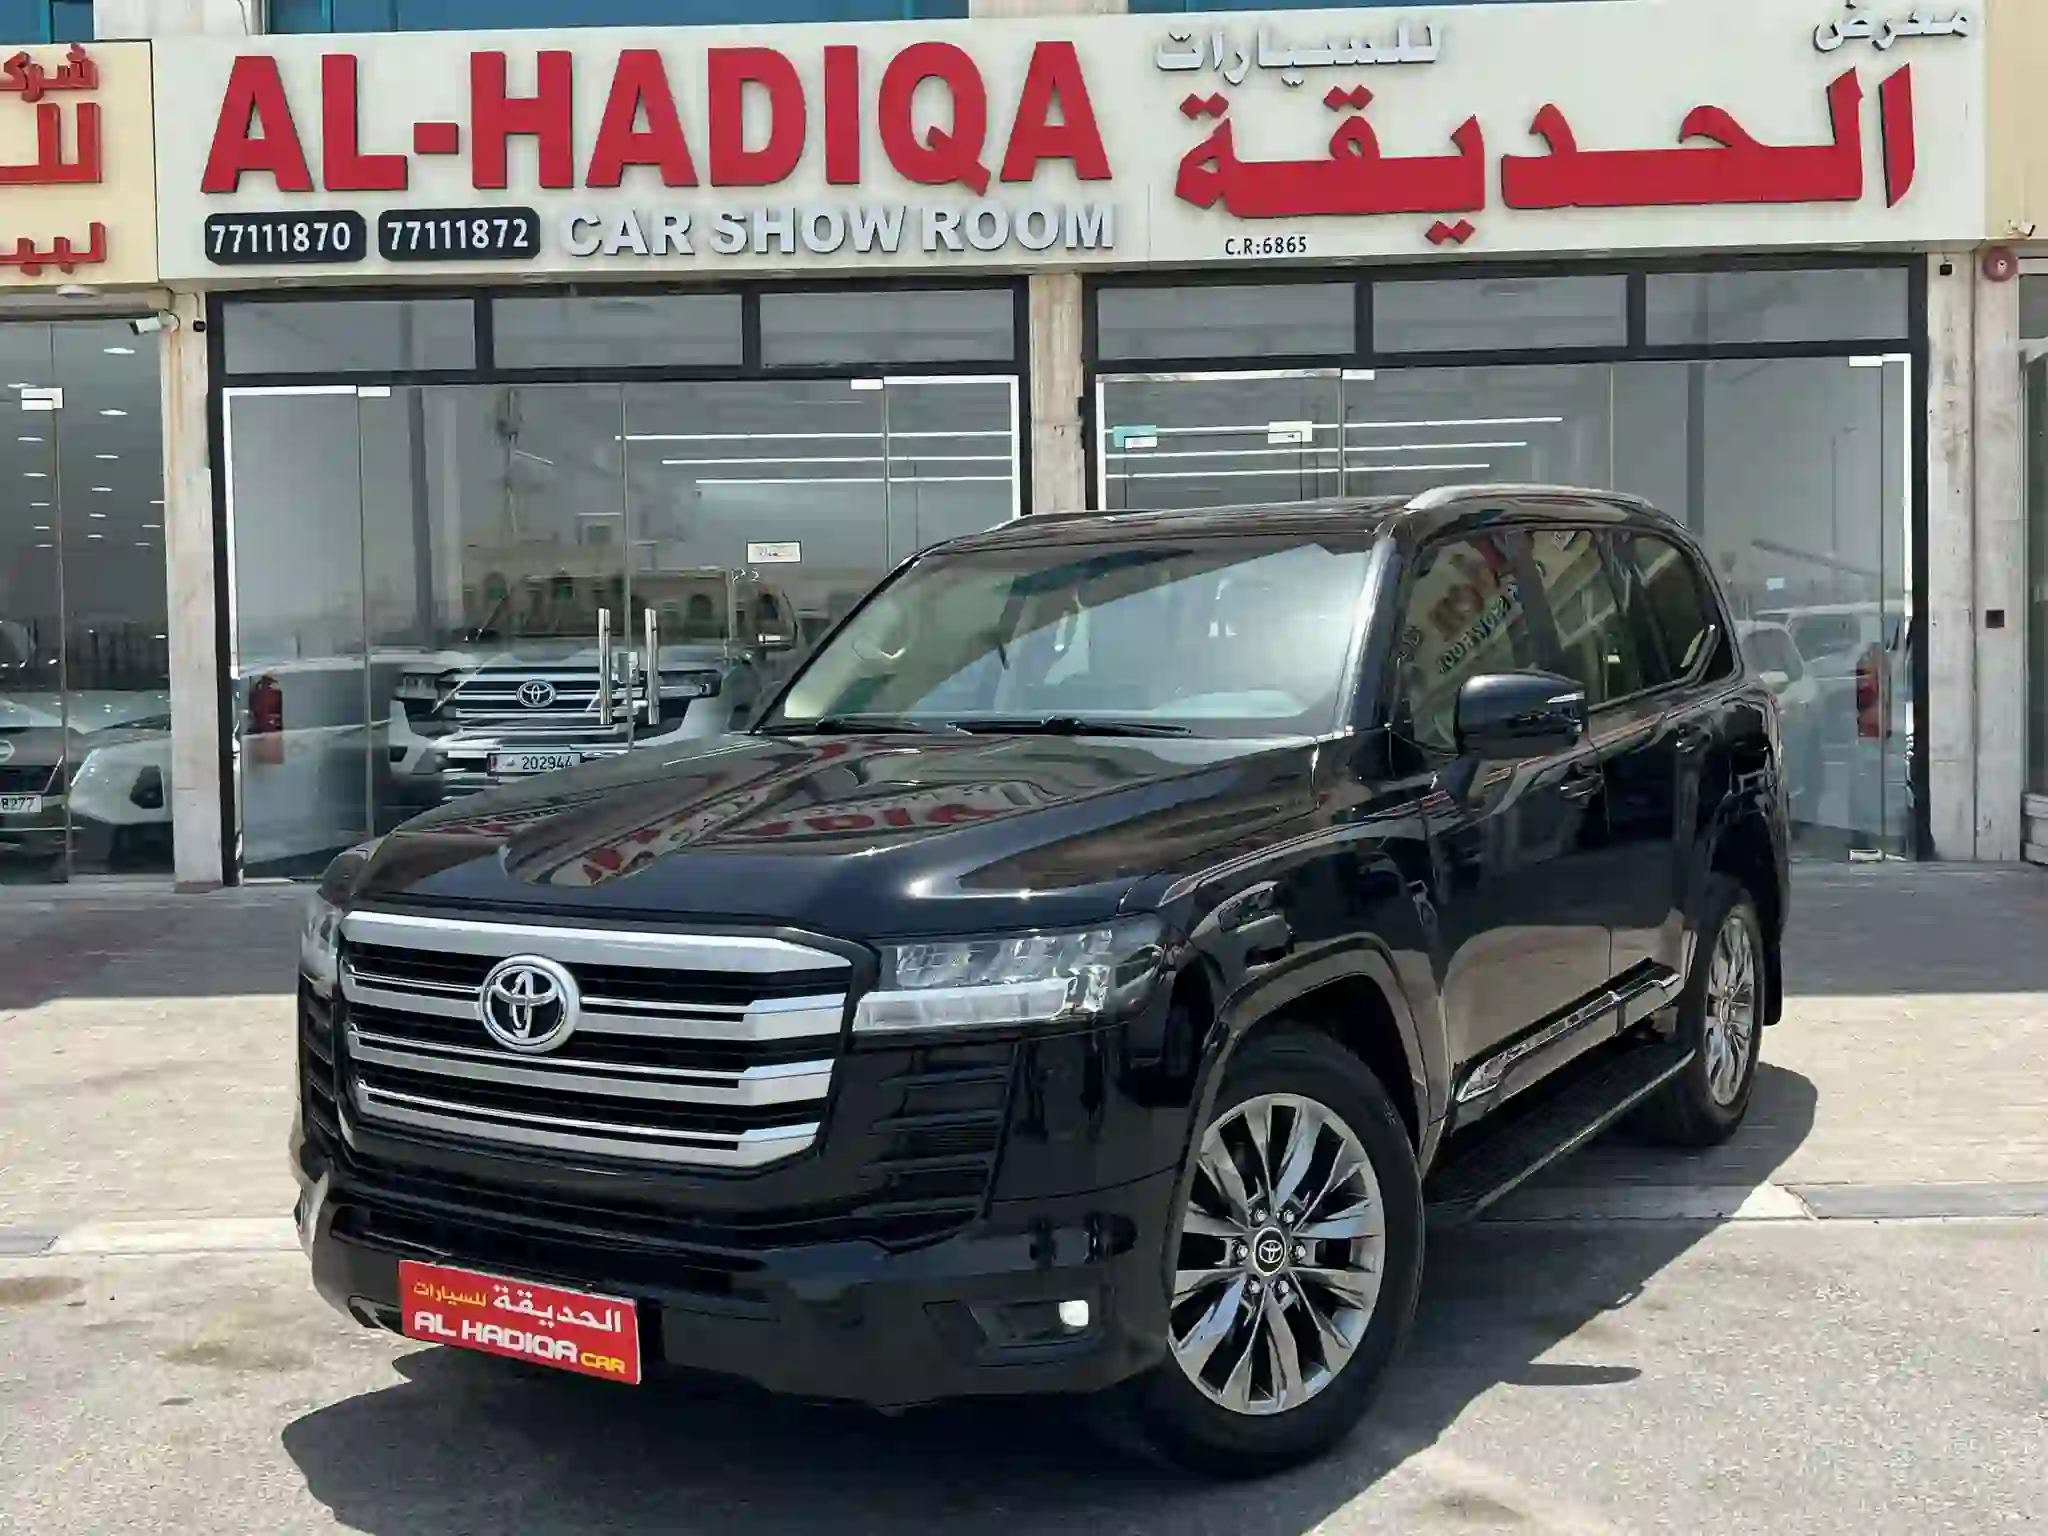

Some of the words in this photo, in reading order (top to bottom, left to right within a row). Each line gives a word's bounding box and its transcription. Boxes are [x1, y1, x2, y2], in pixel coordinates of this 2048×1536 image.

[1156, 21, 1442, 86] للسيارات
[1813, 1, 1970, 53] معرض
[0, 43, 99, 102] شرك
[201, 40, 1112, 196] AL-HADIQA
[1175, 62, 1915, 246] الحديقة
[210, 222, 351, 253] 77111870
[387, 219, 529, 250] 77111872
[559, 208, 695, 256] CAR
[709, 204, 906, 255] SHOW
[921, 201, 1114, 252] ROOM
[1225, 236, 1307, 255] C.R:6865
[413, 1281, 487, 1308] للسيارات
[492, 1284, 622, 1333] الحديقة
[414, 1310, 457, 1337] AL
[580, 1352, 626, 1374] CAR
